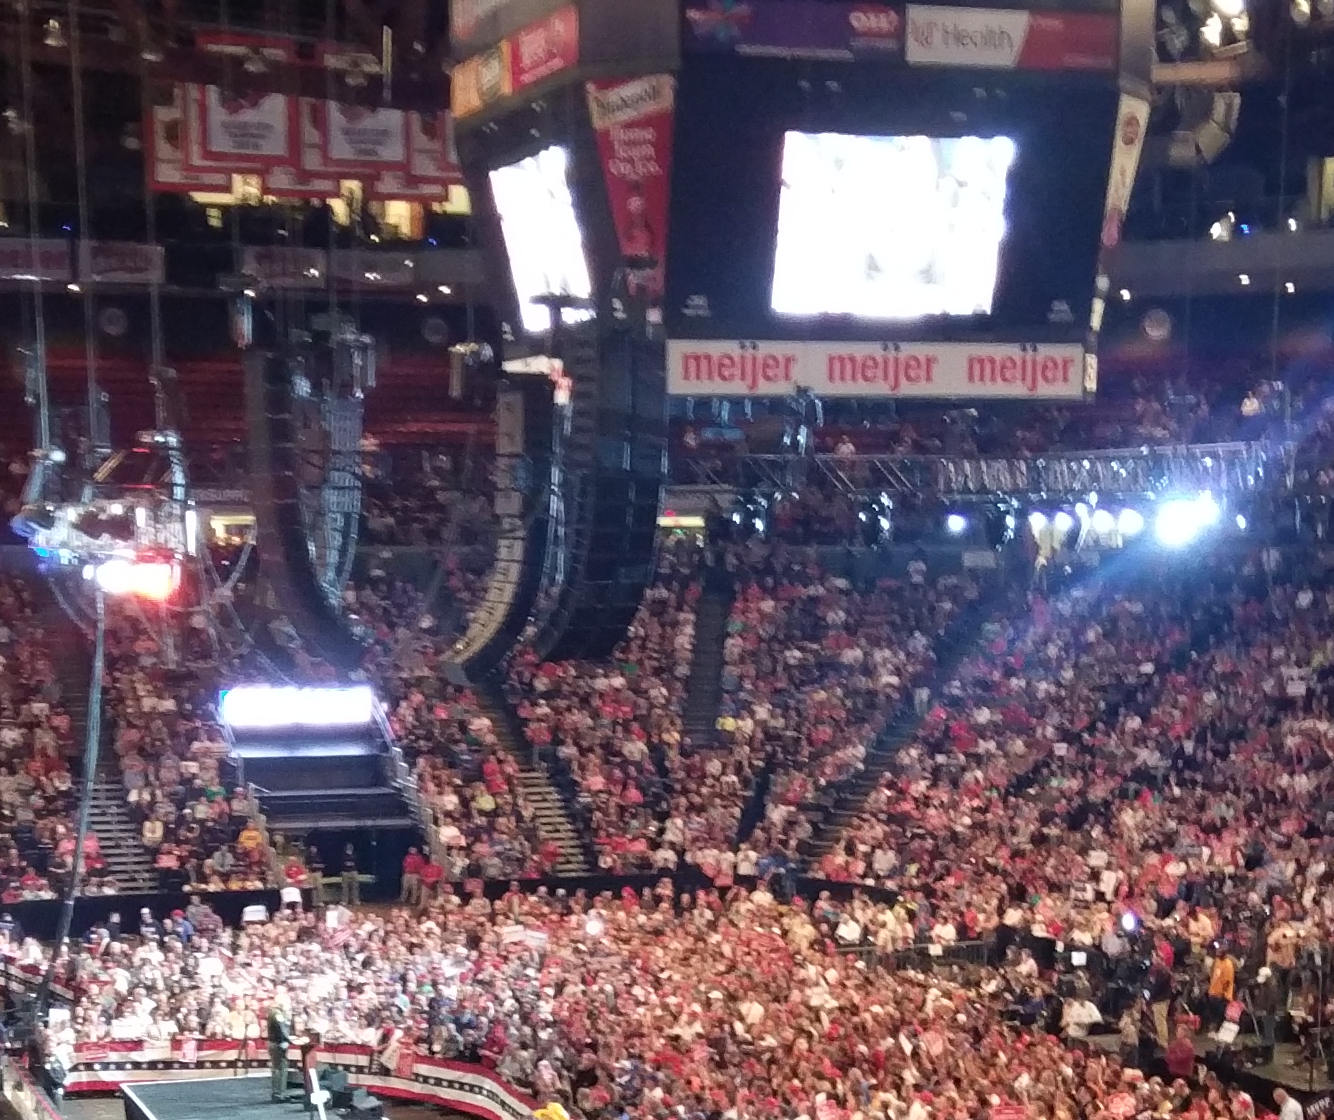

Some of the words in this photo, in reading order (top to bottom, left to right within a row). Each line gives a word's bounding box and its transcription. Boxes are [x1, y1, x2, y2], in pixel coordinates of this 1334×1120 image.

[681, 340, 798, 393] meijer
[827, 341, 938, 393] meijer
[967, 342, 1075, 393] meijer
